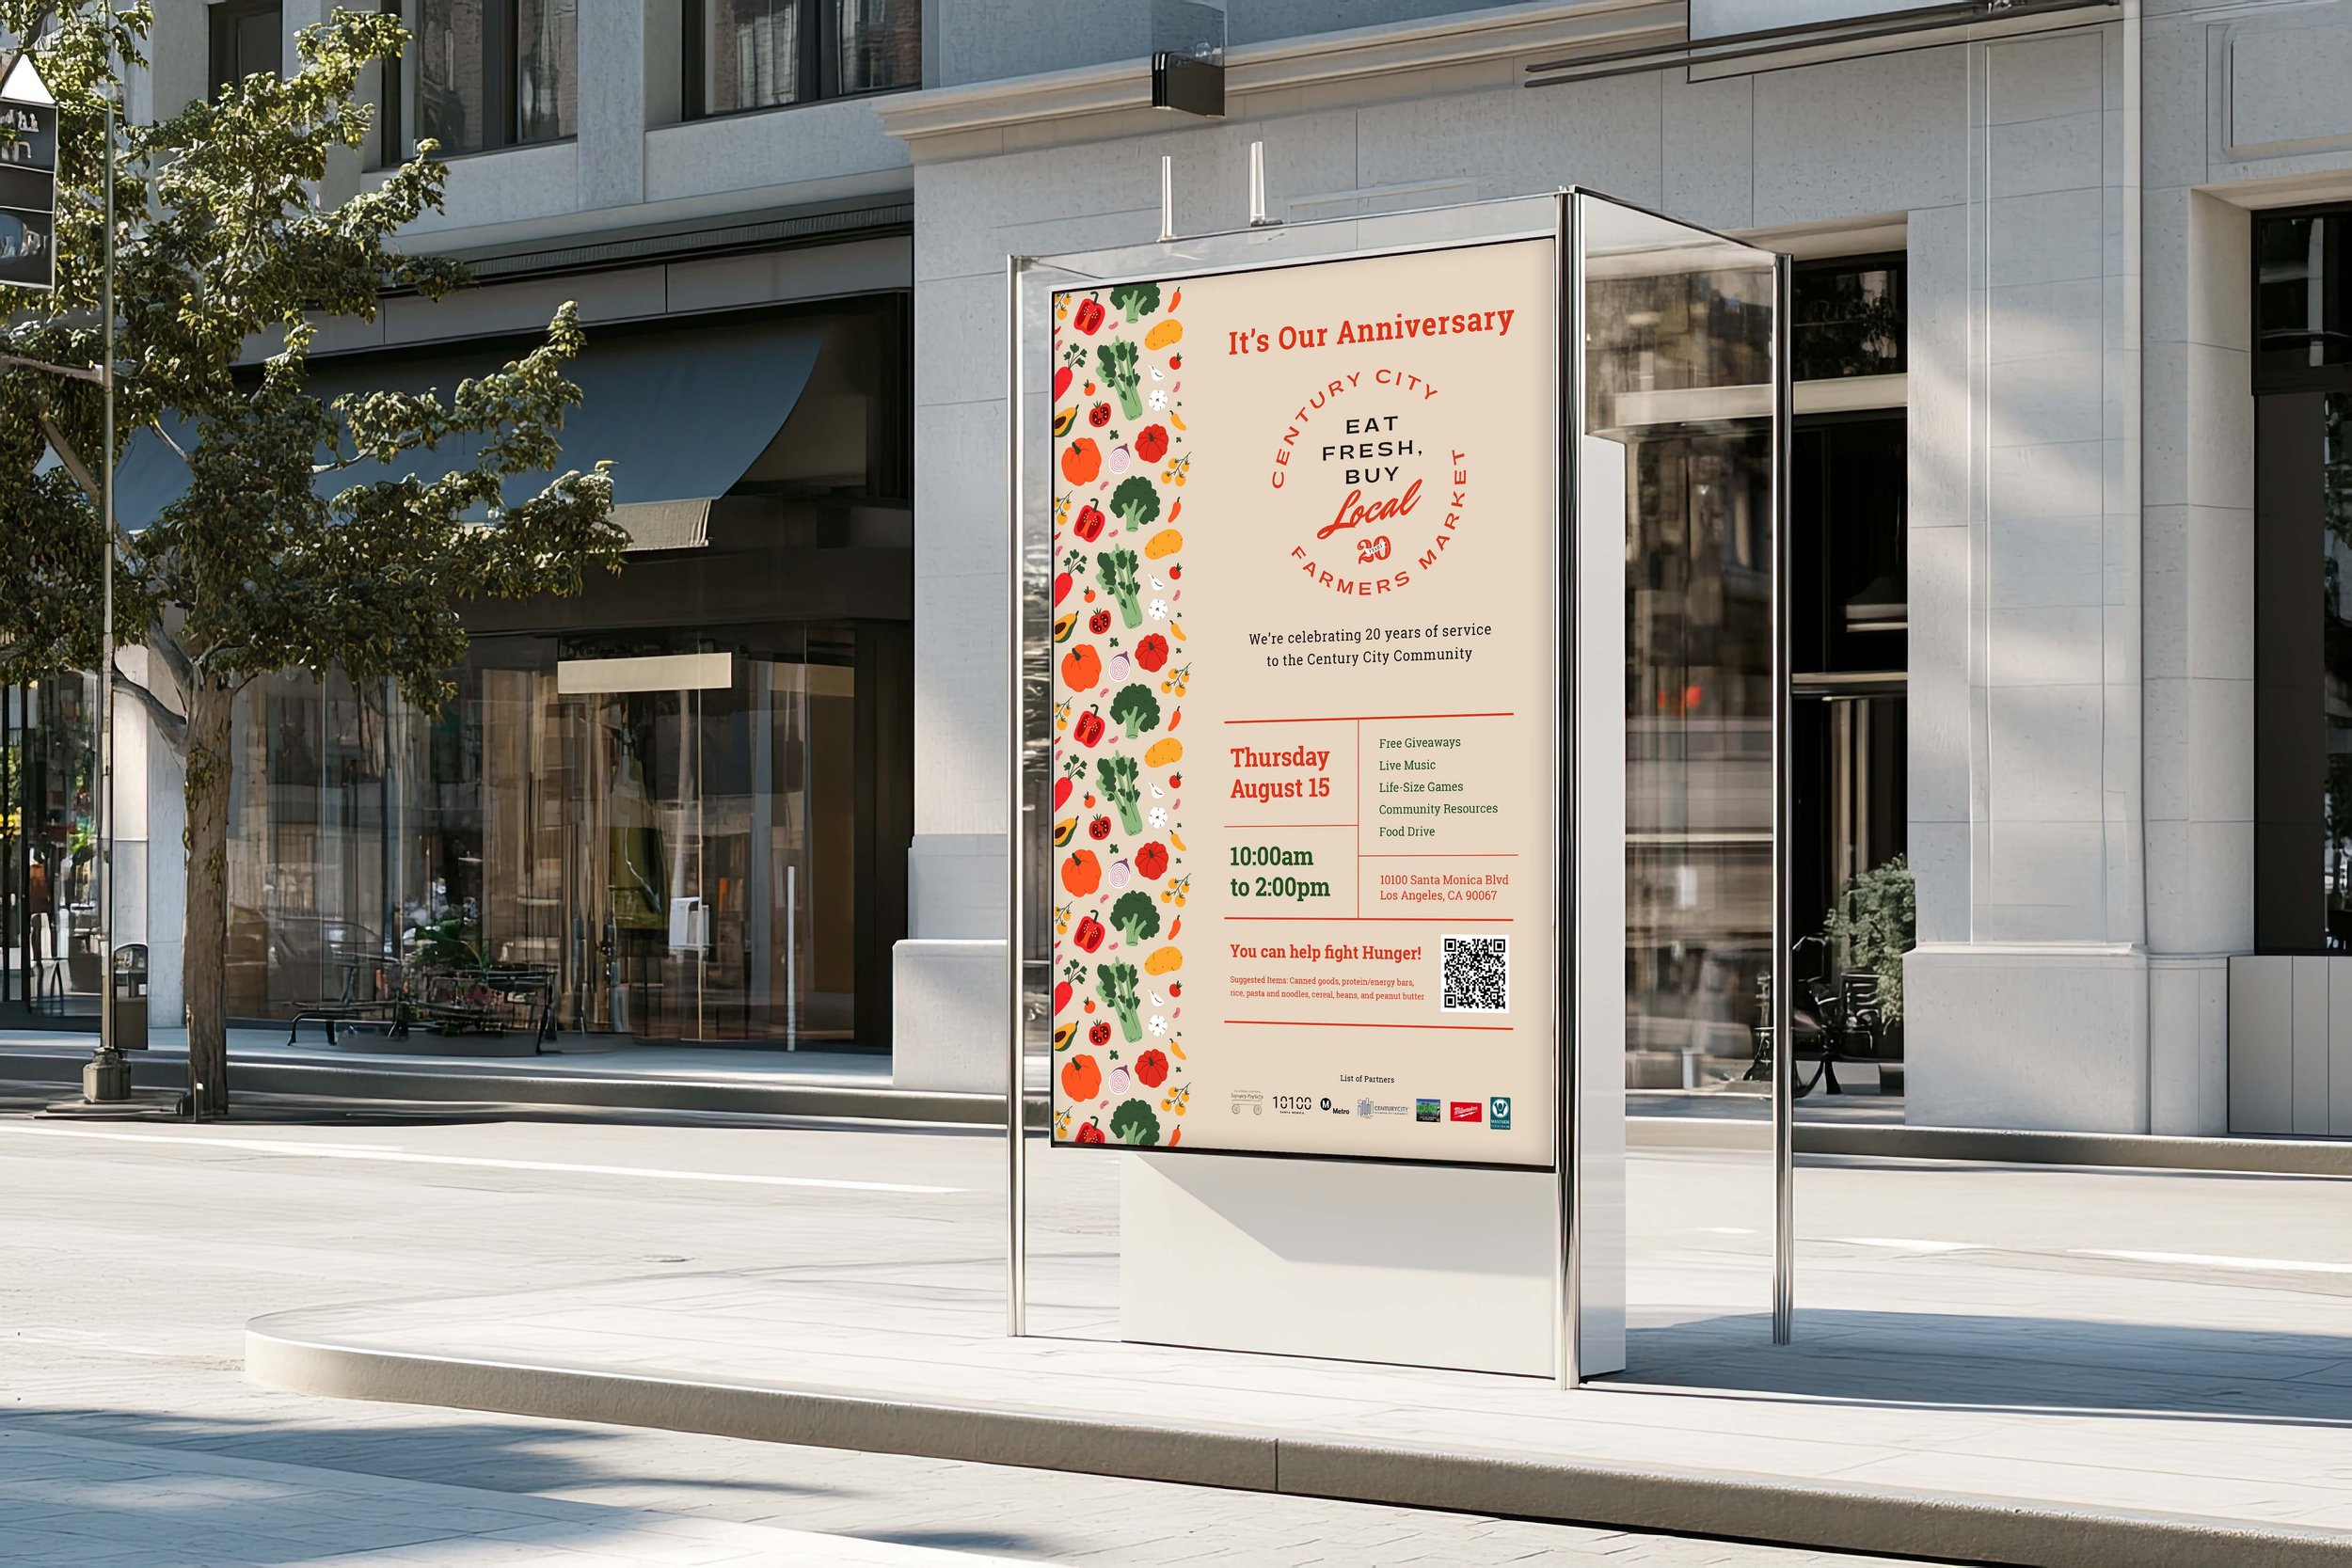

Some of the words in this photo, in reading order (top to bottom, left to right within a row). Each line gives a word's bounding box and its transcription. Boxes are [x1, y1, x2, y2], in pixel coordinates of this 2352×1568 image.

[1279, 326, 1327, 350] Our
[1337, 309, 1514, 344] Anniversary
[1272, 372, 1361, 489] CENTURY
[1375, 369, 1438, 401] CITY
[1346, 416, 1398, 434] EAT
[1323, 440, 1422, 461] FRESH,
[1346, 467, 1399, 484] BUY
[1316, 478, 1423, 540] Local
[1291, 546, 1410, 596] FARMERS
[1418, 449, 1467, 570] MARKET
[1357, 535, 1391, 564] 20
[1288, 629, 1360, 643] celebrating
[1366, 628, 1380, 640] 20
[1385, 629, 1421, 642] years
[1425, 625, 1438, 638] of
[1442, 623, 1491, 637] service
[1267, 657, 1279, 666] to
[1283, 654, 1303, 666] the
[1307, 653, 1359, 666] Century
[1363, 650, 1390, 666] City
[1394, 647, 1472, 662] Community
[1379, 739, 1402, 748] Free
[1405, 737, 1460, 749] Giveaways
[1231, 746, 1329, 771] Thursday
[1379, 760, 1401, 770] Live
[1405, 760, 1436, 769] Music
[1231, 779, 1303, 803] August
[1309, 778, 1329, 797] 15
[1379, 782, 1424, 792] Life-Size
[1428, 782, 1463, 791] Games
[1379, 803, 1440, 816] Community
[1444, 804, 1498, 814] Resources
[1379, 826, 1405, 836] Food
[1407, 826, 1435, 836] Drive
[1231, 847, 1313, 865] 10:00am
[1381, 875, 1407, 884] 10100
[1411, 875, 1439, 884] Santa
[1443, 875, 1482, 884] Monica
[1486, 875, 1509, 884] Blvd
[1231, 879, 1249, 896] to
[1256, 877, 1330, 901] 2:00pm
[1380, 891, 1398, 900] Los
[1401, 890, 1445, 902] Angeles,
[1448, 891, 1463, 900] CA
[1466, 891, 1497, 900] 90067
[1231, 944, 1257, 958] You
[1261, 948, 1286, 958] can
[1290, 944, 1321, 962] help
[1325, 944, 1359, 962] fight
[1362, 946, 1421, 963] Hunger!
[1231, 976, 1265, 985] Suggested
[1318, 977, 1340, 986] goods,
[1342, 978, 1395, 988] protein/energy
[1397, 978, 1414, 987] bars,
[1281, 990, 1310, 999] noodles,
[1273, 1096, 1311, 1110] 10100
